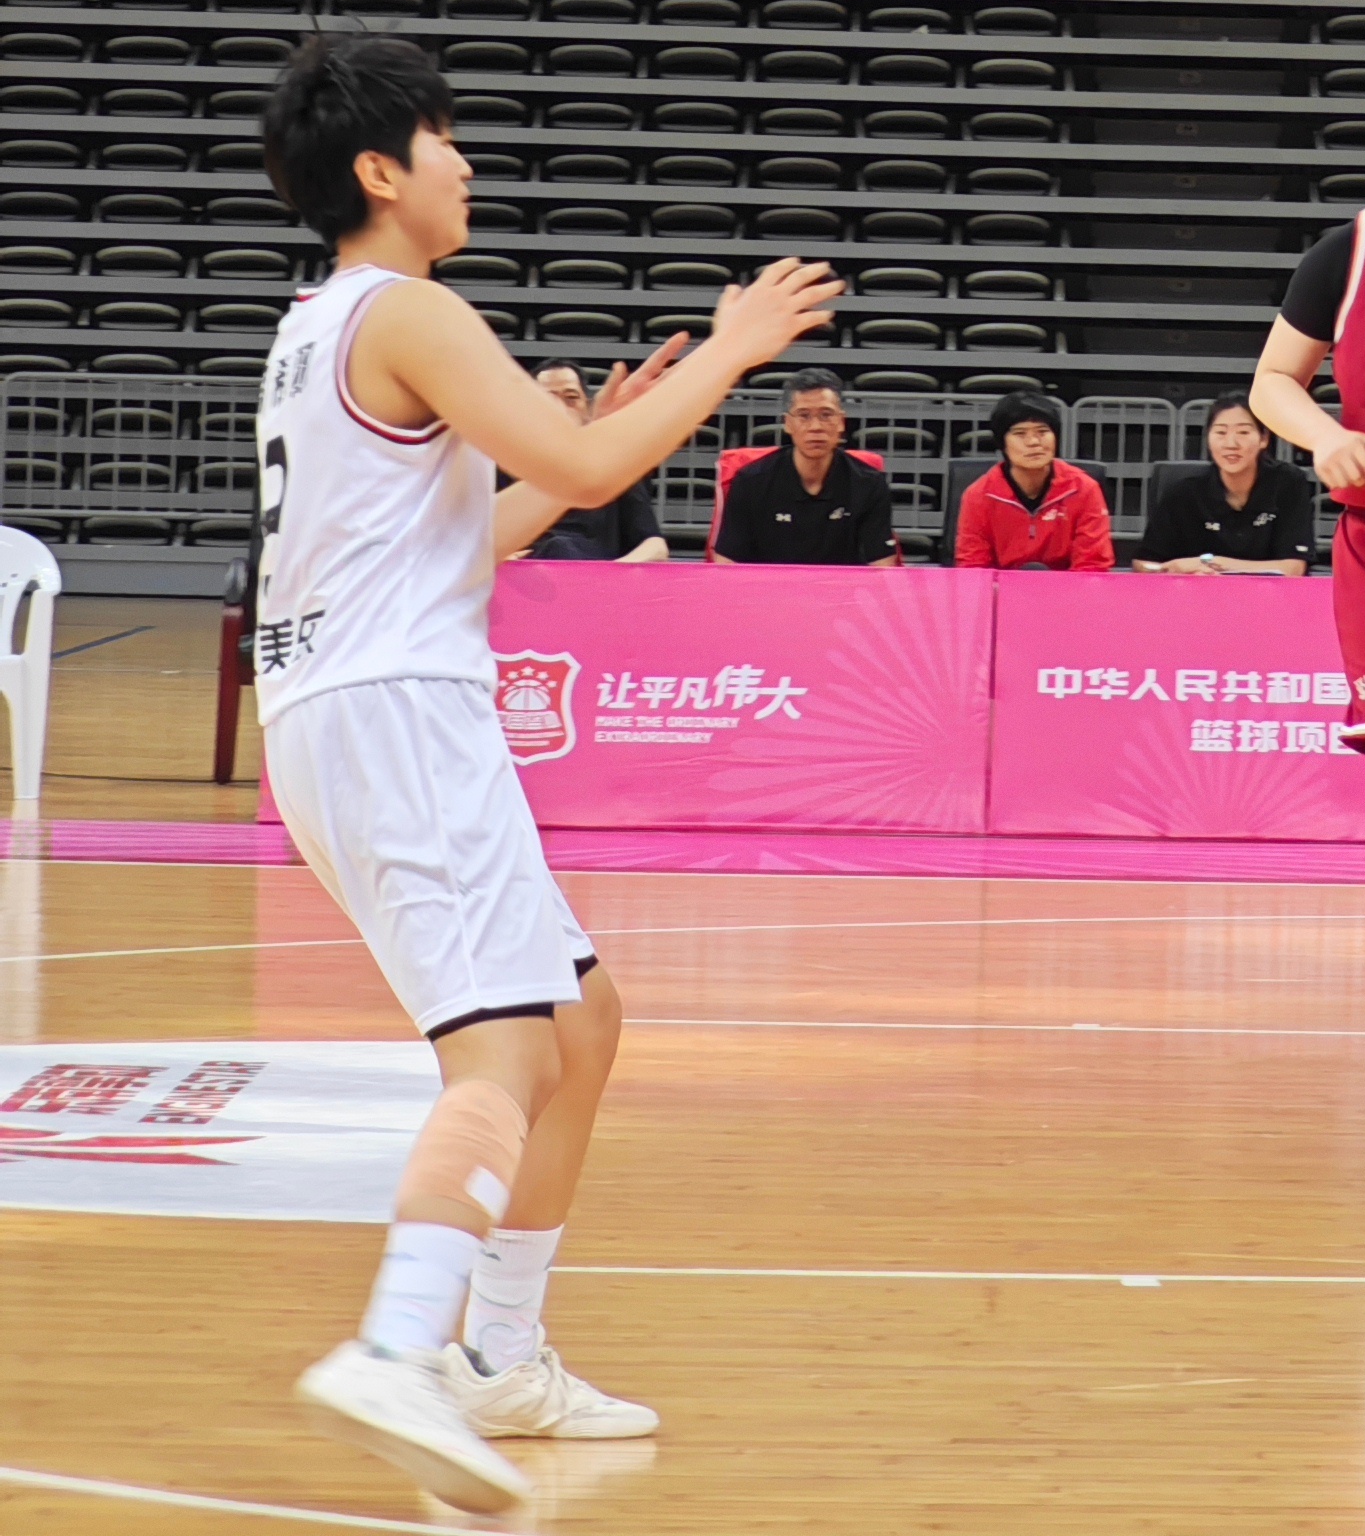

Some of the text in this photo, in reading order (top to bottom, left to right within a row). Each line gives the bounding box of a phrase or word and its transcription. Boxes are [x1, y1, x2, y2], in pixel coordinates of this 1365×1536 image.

[596, 664, 808, 720] 让平凡伟大
[1037, 666, 1353, 705] 中华人民共和国
